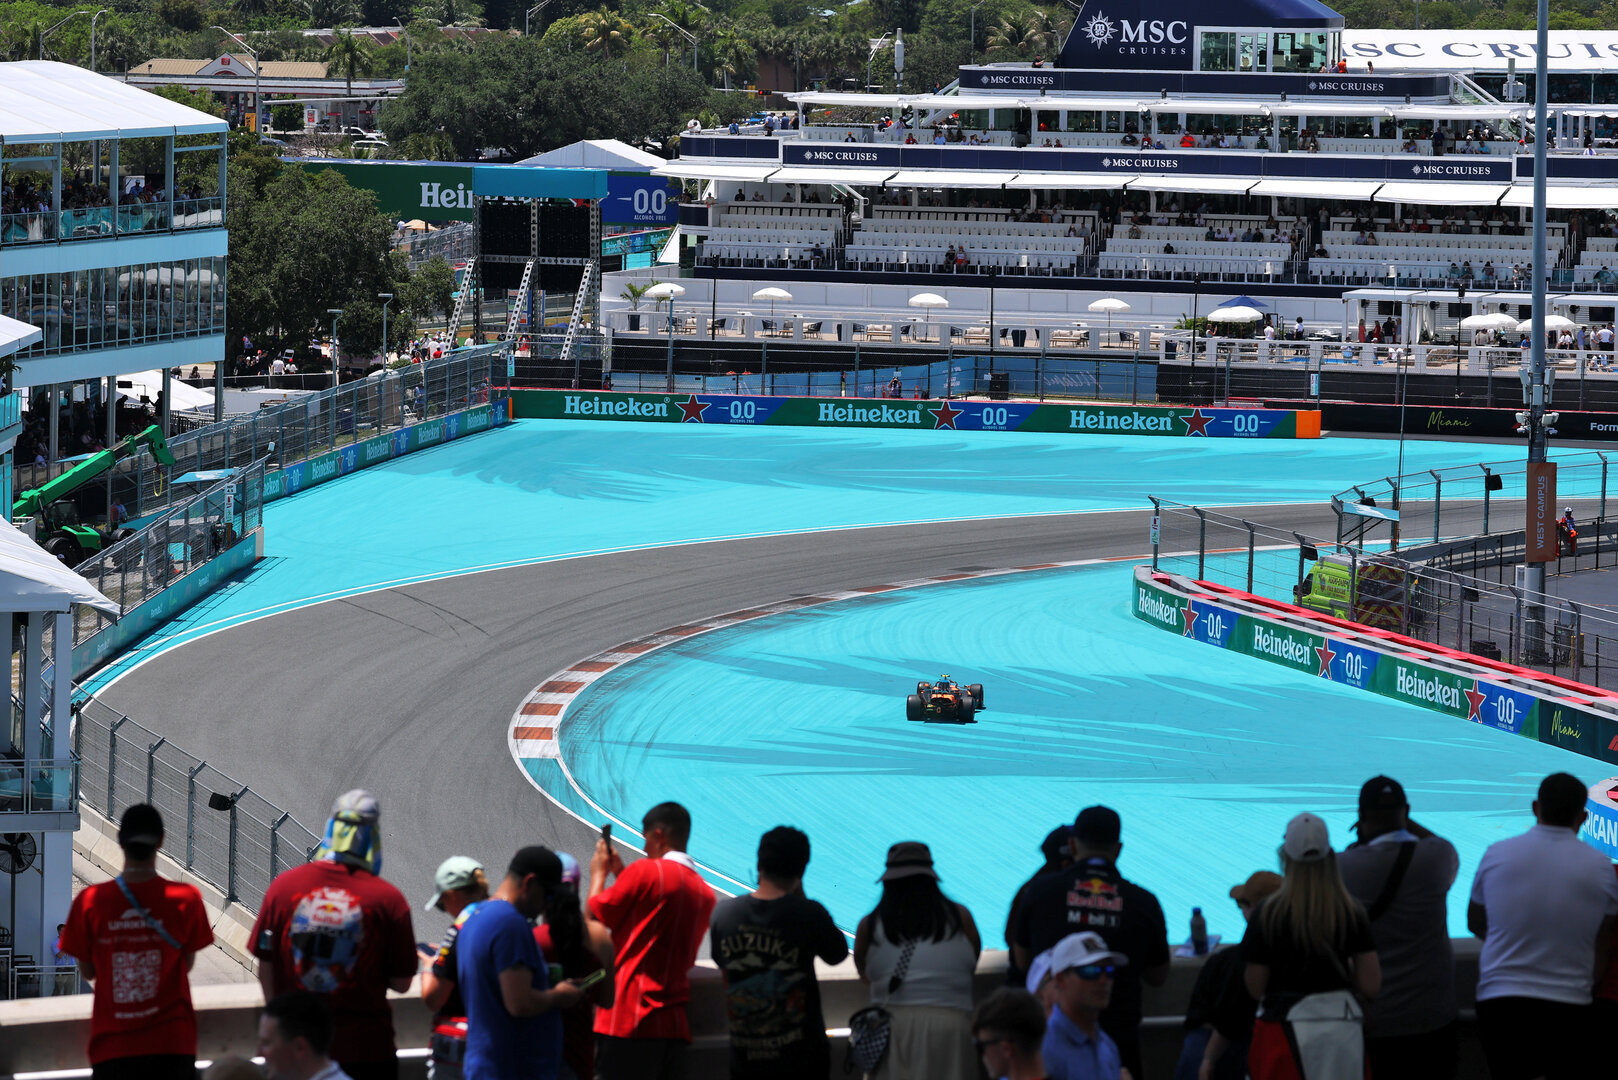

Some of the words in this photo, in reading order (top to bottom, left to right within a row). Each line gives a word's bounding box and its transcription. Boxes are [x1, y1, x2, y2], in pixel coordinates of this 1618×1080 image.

[1120, 20, 1187, 44] MSC
[1118, 47, 1186, 55] CRUISES
[1342, 43, 1425, 57] SC
[990, 75, 1010, 84] MSC
[1011, 75, 1054, 85] CRUISES
[1318, 82, 1339, 90] MSC
[1340, 82, 1384, 91] CRUISES
[814, 151, 834, 160] MSC
[835, 152, 878, 161] CRUISES
[1112, 158, 1133, 167] MSC
[1134, 159, 1178, 168] CRUISES
[1422, 165, 1444, 174] MSC
[1445, 166, 1491, 175] CRUISES
[634, 188, 666, 215] 0.0
[564, 395, 668, 417] Heineken
[730, 400, 755, 419] 0.0
[818, 402, 921, 424] Heineken
[982, 407, 1007, 426] 0.0
[1069, 410, 1172, 431] Heineken
[1234, 414, 1258, 433] 0.0
[1427, 410, 1473, 431] Miami
[366, 440, 389, 460] Heineken
[312, 458, 336, 480] Heineken
[1537, 476, 1545, 519] CAMPUS
[1536, 521, 1545, 549] WEST
[1138, 587, 1177, 626] Heineken
[1208, 613, 1221, 640] 0.0
[1253, 625, 1311, 666] Heineken
[1346, 651, 1362, 680] 0.0
[1396, 666, 1461, 709] Heineken
[1497, 695, 1514, 724] 0.0
[1551, 710, 1583, 741] Miami
[1584, 807, 1618, 848] RICAN
[721, 932, 800, 963] SUZUKA
